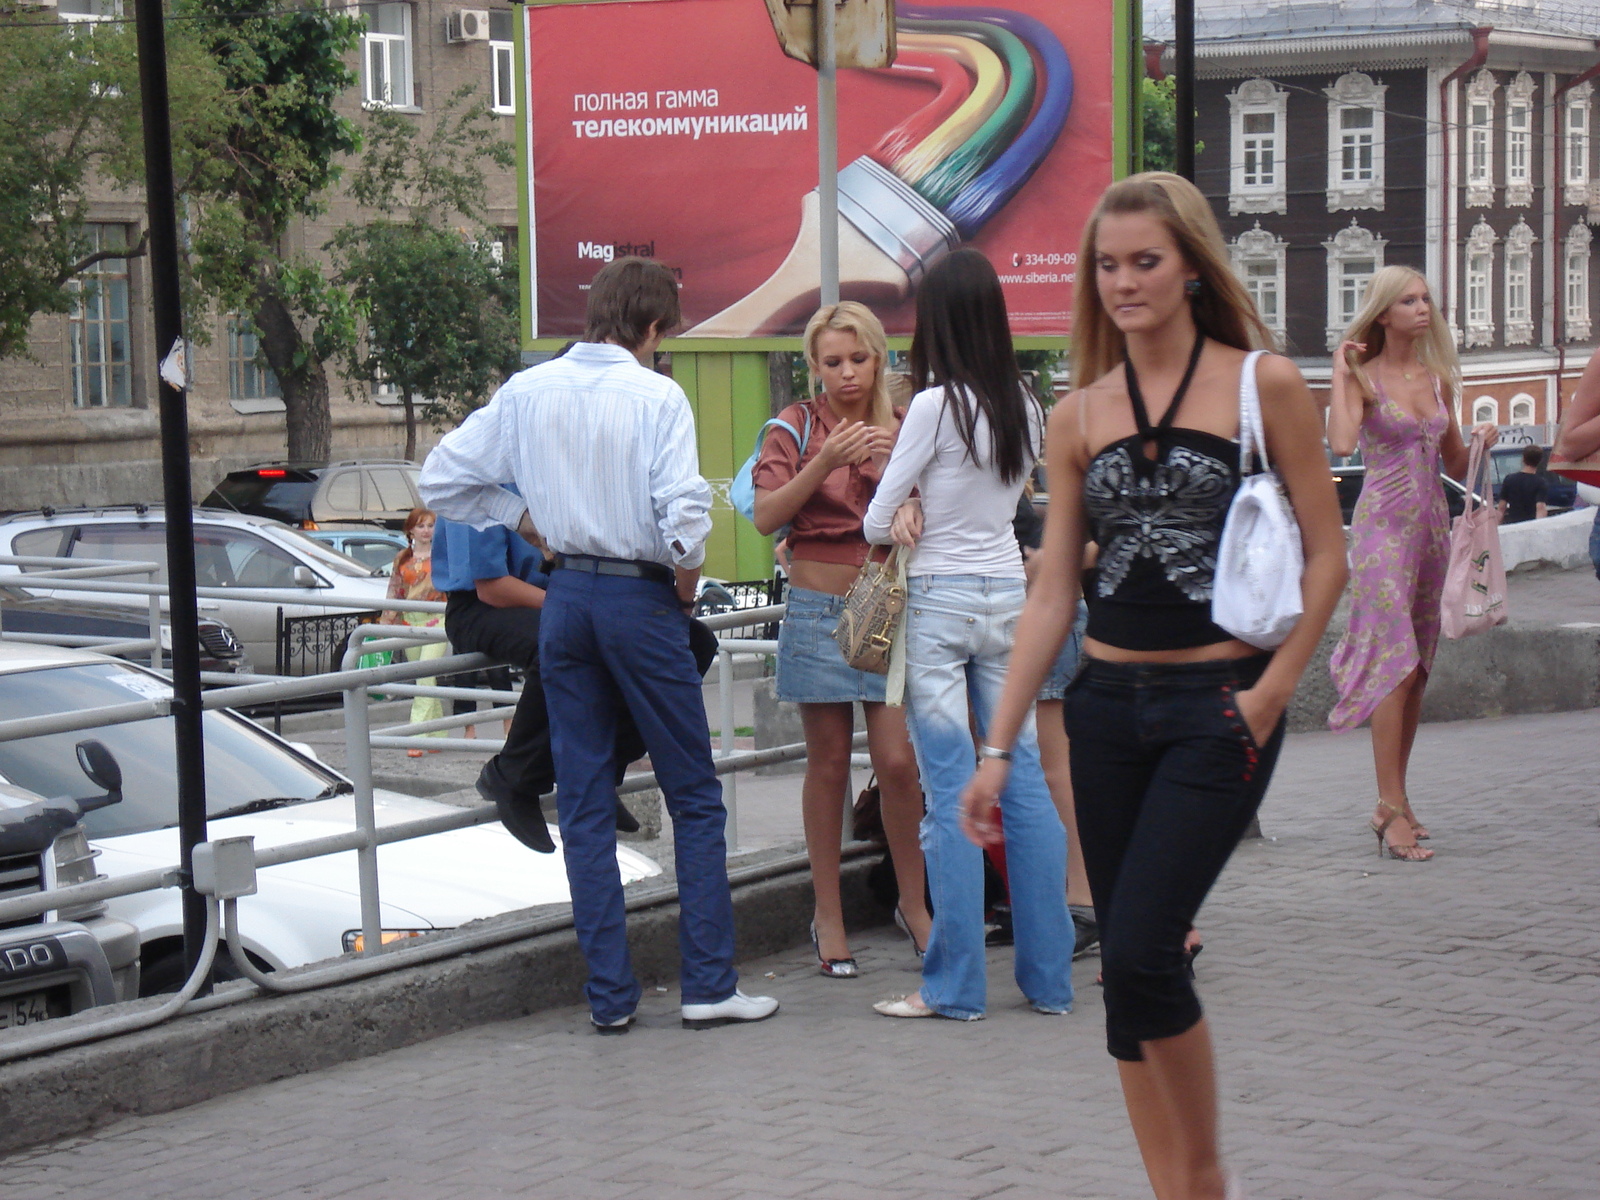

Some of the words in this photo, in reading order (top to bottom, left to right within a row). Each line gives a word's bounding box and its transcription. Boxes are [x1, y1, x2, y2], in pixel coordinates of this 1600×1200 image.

[574, 91, 649, 112] полная
[655, 88, 719, 109] гамма
[571, 104, 808, 140] телекоммуникаций
[577, 240, 655, 263] Magistral
[1024, 253, 1077, 266] 334-09-09
